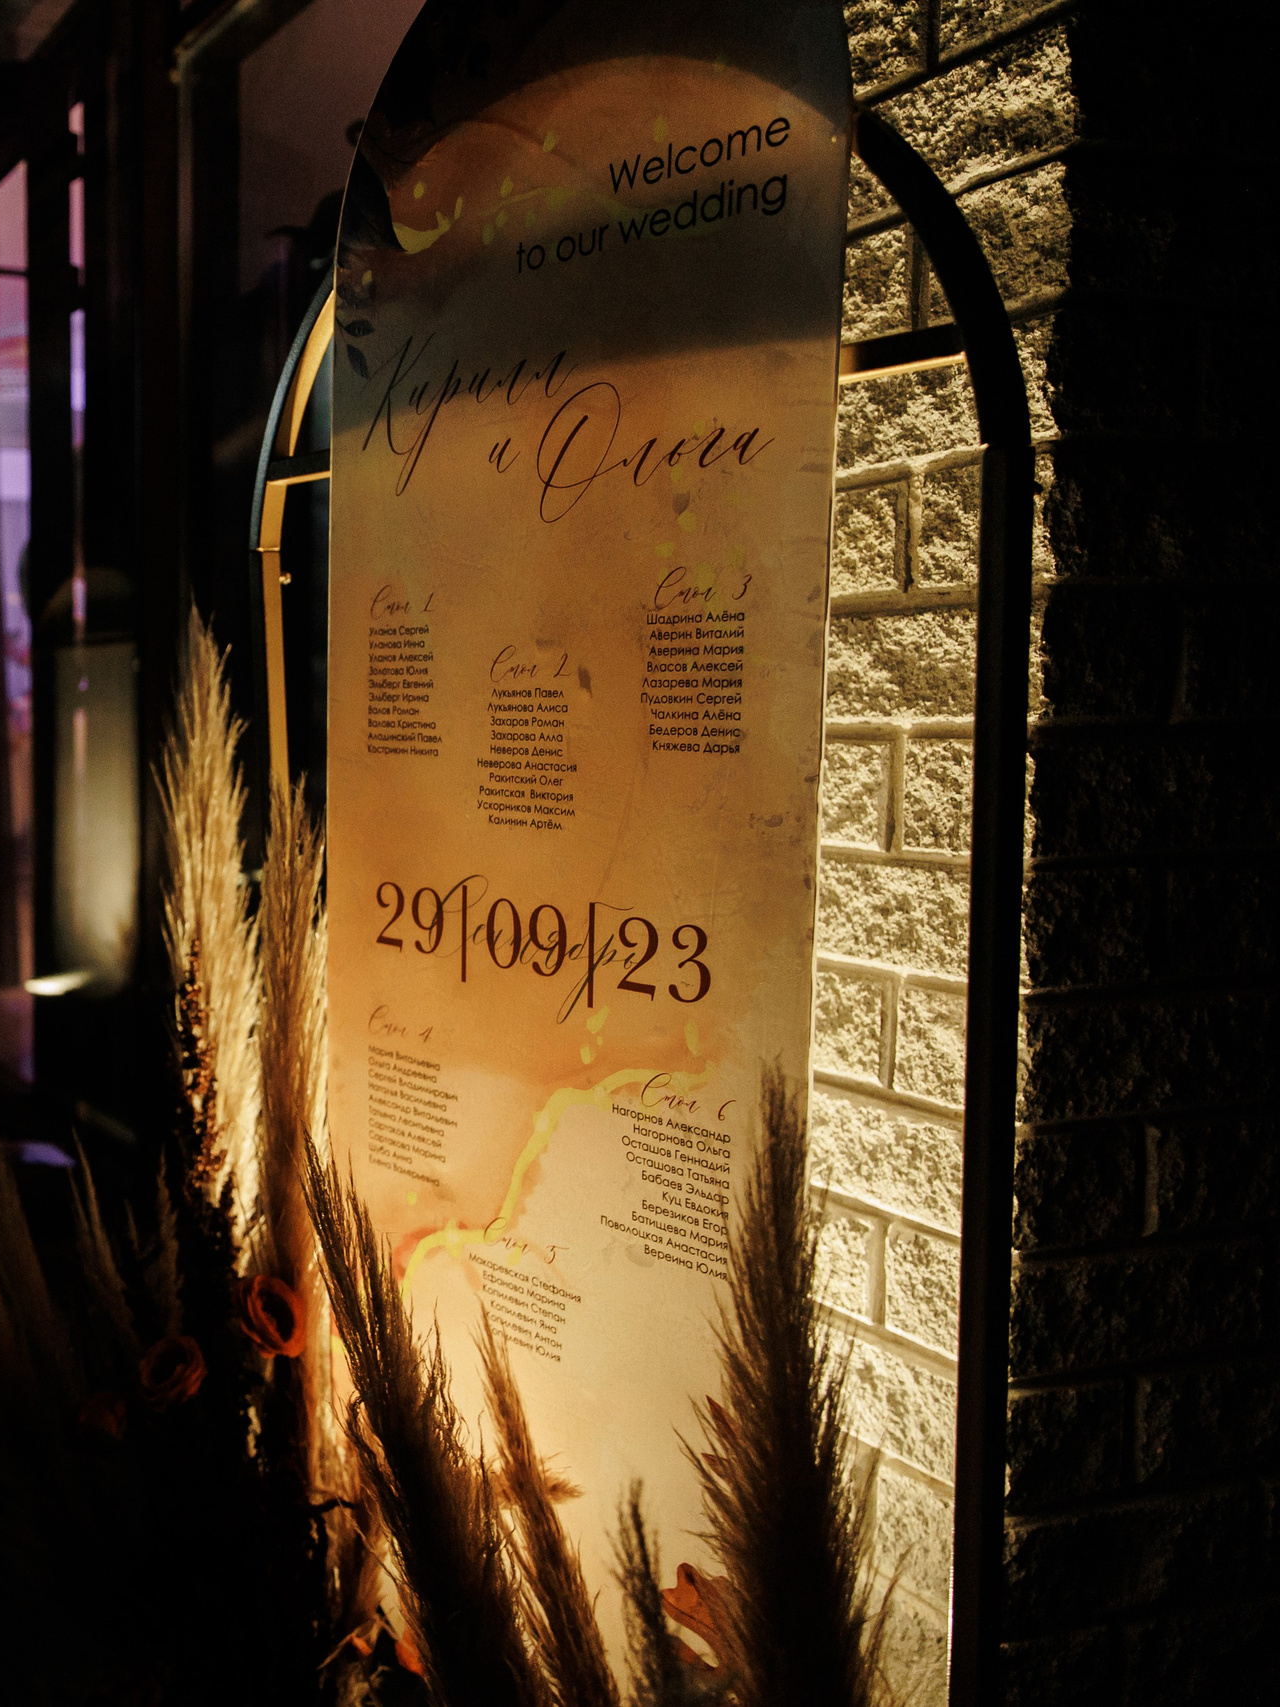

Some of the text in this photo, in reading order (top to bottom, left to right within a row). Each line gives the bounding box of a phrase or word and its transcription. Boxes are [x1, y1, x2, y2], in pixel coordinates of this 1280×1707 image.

[607, 116, 791, 195] Welcome
[516, 174, 789, 274] to our wedding
[362, 332, 580, 497] Кирилл
[489, 381, 776, 524] и Ольга
[654, 566, 752, 609] Стол 3
[370, 585, 436, 620] Стол 1
[647, 611, 745, 626] Шадрина Алёна
[369, 625, 429, 636] Уланов Сергей
[649, 626, 744, 642] Аверин Виталий
[369, 640, 425, 649] Уланова Инна
[649, 645, 744, 658] Аверина Мария
[369, 652, 433, 663] Уланов Алексей
[490, 645, 572, 683] Стол 2
[406, 666, 428, 675] Юлия
[647, 660, 743, 672] Власов Алексей
[369, 679, 433, 689] Эльберг Евгений
[642, 678, 742, 690] Лазарева Мария
[369, 693, 429, 703] Эльберг Ирина
[492, 688, 564, 699] Лукьянов Павел
[641, 692, 742, 706] Пудовкин Сергей
[393, 706, 419, 715] Роман
[487, 702, 568, 713] Лукьянова Алиса
[651, 708, 741, 720] Чалкина Алёна
[398, 720, 436, 729] Кристина
[490, 716, 564, 728] Захаров Роман
[418, 733, 442, 743] Павел
[491, 731, 563, 742] Захарова Алла
[649, 724, 740, 737] Бедеров Денис
[410, 746, 438, 756] Никита
[490, 745, 563, 757] Неверов Денис
[652, 740, 740, 755] Княжева Дарья
[477, 758, 577, 772] Неверова Анастасия
[490, 773, 563, 786] Ракитский Олег
[480, 786, 573, 802] Ракитская Виктория
[477, 800, 575, 816] Ускорников Максим
[489, 815, 562, 830] Калинин Артём
[640, 1072, 736, 1121] Стол 6
[612, 1103, 730, 1144] Нагорнов Александр
[633, 1123, 730, 1158] Нагорнова Ольга
[621, 1135, 730, 1174] Осташов Геннадий
[626, 1151, 730, 1189] Осташова Татьяна
[641, 1170, 729, 1205] Бабаев Эльдар
[662, 1191, 729, 1220] Куц Евдокия
[642, 1199, 728, 1236] Березиков Егор
[631, 1211, 728, 1250] Батищева Мария
[484, 1217, 570, 1264] Стол 5
[600, 1215, 728, 1265] Поволоцкая Анастасия
[644, 1244, 728, 1281] Вереина Юлия
[468, 1252, 582, 1303] Макаревская Стефания
[482, 1270, 566, 1311] Ефанова Марина
[482, 1284, 566, 1324] Копилевич Степан
[491, 1299, 557, 1334] Копилевич Яна
[534, 1331, 562, 1349] Антон
[536, 1345, 561, 1362] Юлия
